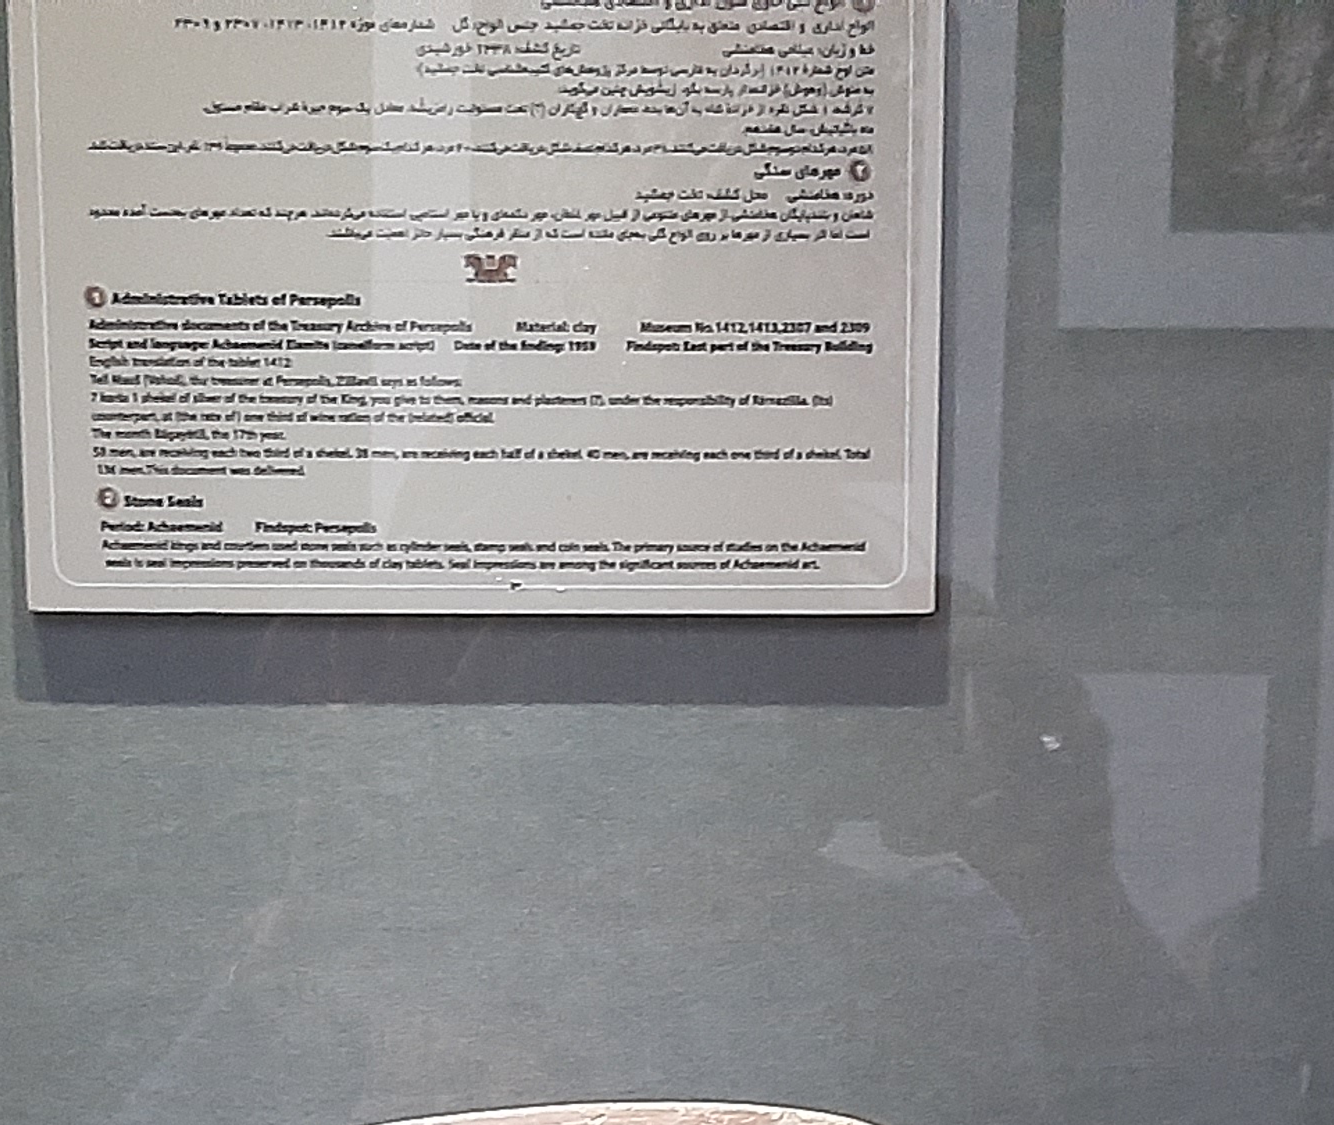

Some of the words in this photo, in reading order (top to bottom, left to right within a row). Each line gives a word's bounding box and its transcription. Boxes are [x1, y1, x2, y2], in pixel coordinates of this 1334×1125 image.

[110, 292, 216, 306] Administrative
[217, 292, 269, 306] Tablets
[289, 293, 362, 307] Persepolis
